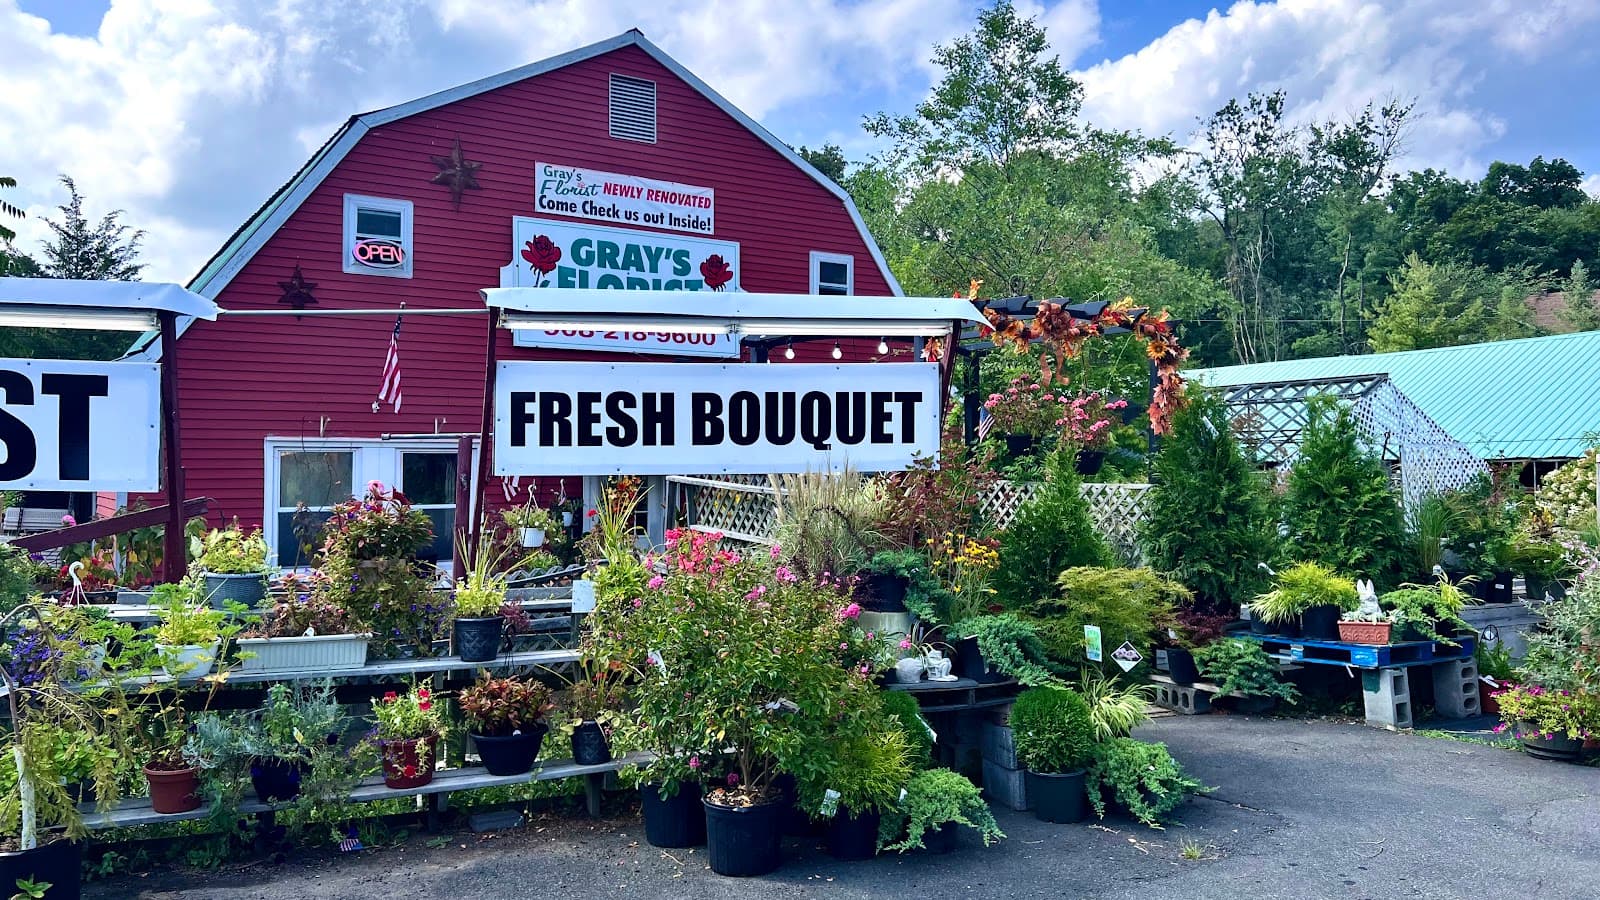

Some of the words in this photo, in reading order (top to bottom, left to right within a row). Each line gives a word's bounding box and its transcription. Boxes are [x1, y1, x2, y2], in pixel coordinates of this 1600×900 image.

[543, 165, 582, 184] Gray's
[540, 179, 602, 197] Florist
[603, 182, 644, 199] NEWLY
[646, 188, 711, 209] RENOVATED
[538, 194, 578, 213] Come
[581, 199, 620, 219] Check
[624, 209, 639, 222] us
[643, 212, 665, 225] out
[668, 212, 711, 231] Inside!
[355, 243, 403, 263] OPEN
[570, 237, 692, 277] GRAY'S
[544, 329, 716, 346] -28-9600
[510, 391, 675, 448] FRESH
[691, 390, 923, 451] BOUQUET
